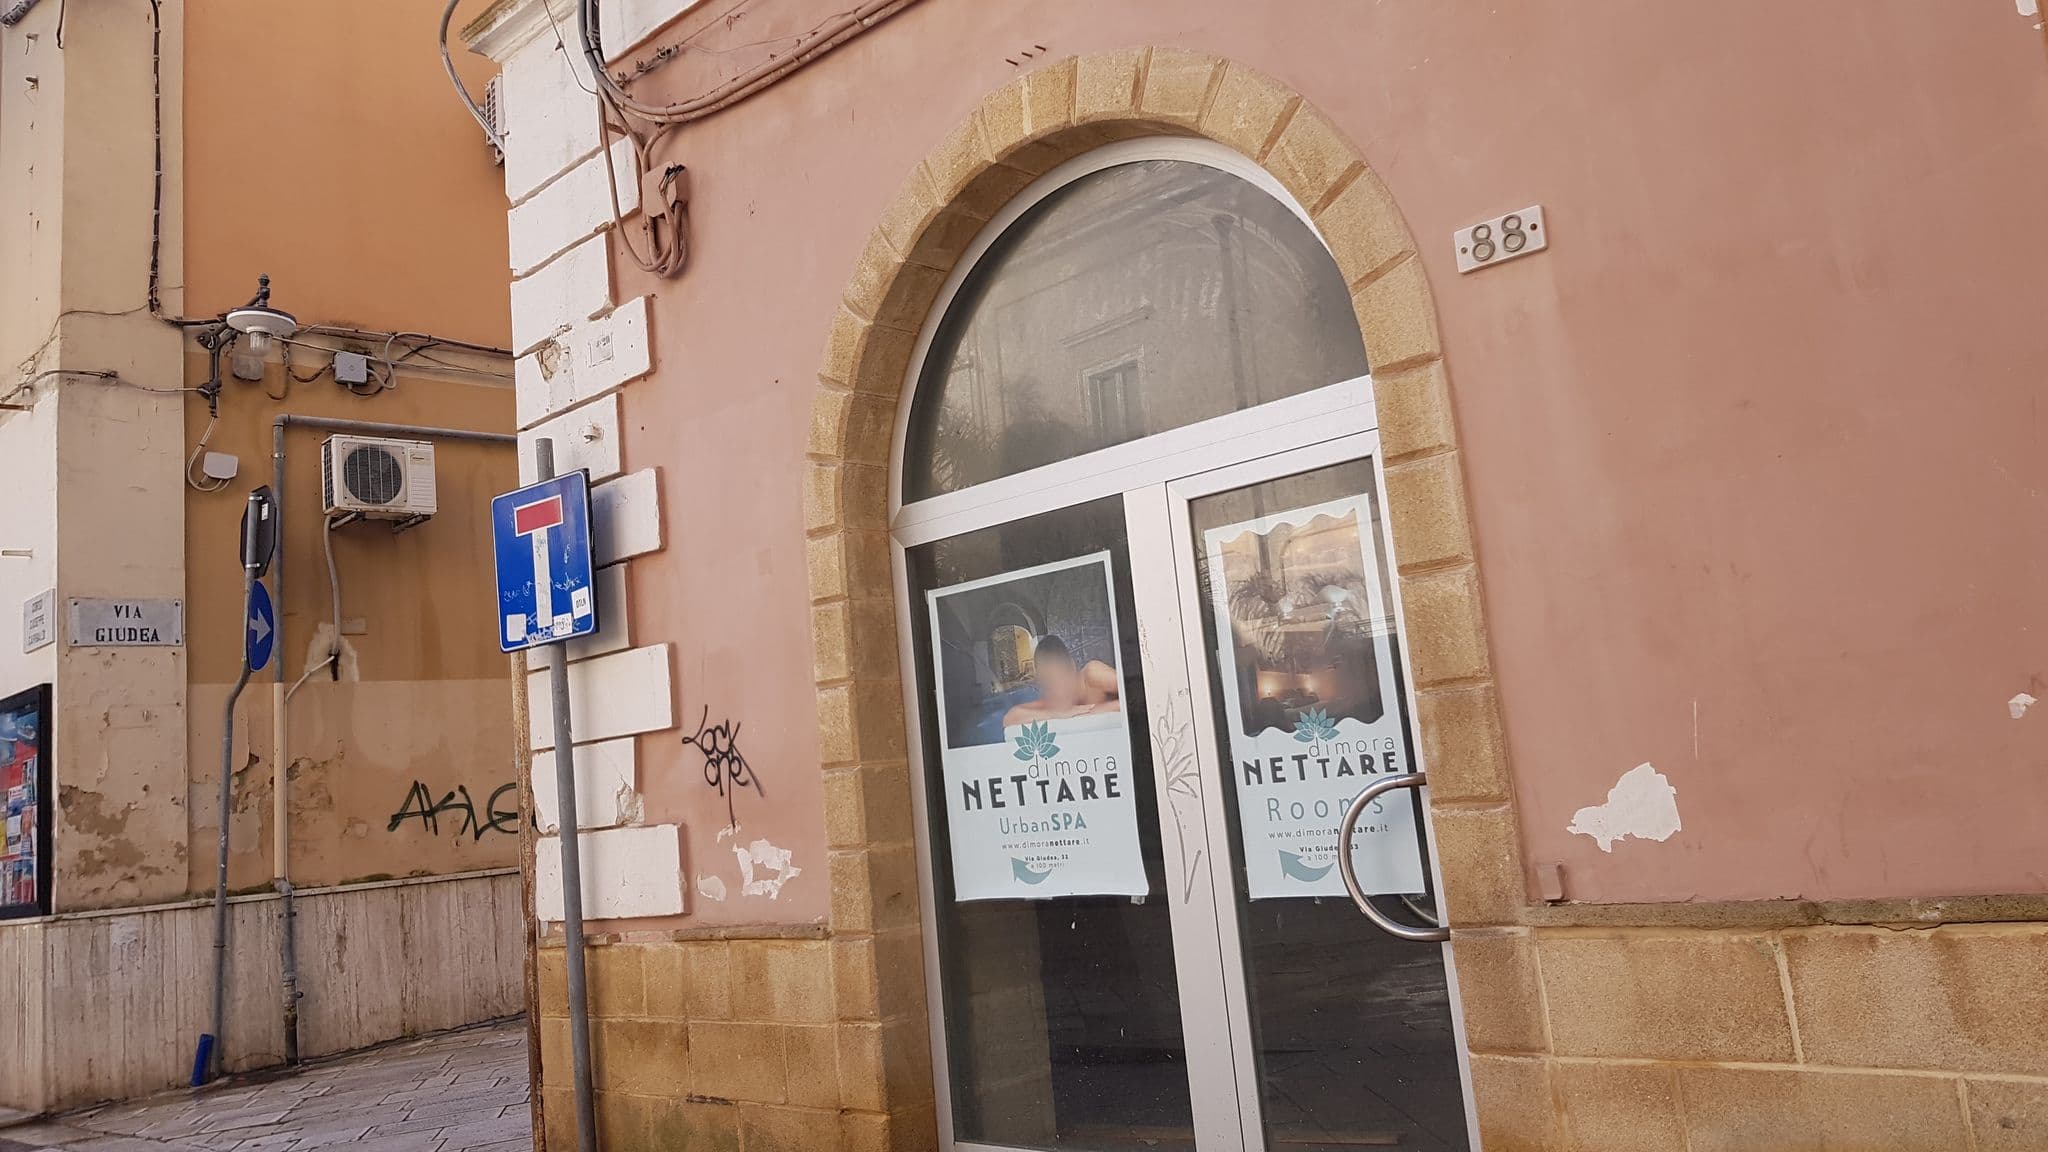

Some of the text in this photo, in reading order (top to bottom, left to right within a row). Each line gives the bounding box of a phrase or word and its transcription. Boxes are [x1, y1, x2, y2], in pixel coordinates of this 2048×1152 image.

[1471, 214, 1527, 262] 88
[113, 604, 143, 619] VIA
[95, 627, 161, 643] GIUDEA
[1309, 737, 1395, 759] dimora
[1028, 754, 1117, 779] dimora
[1242, 751, 1399, 786] NETTARE
[961, 772, 1121, 811] NETTARE
[999, 811, 1087, 835] UrbanSPA
[1001, 838, 1090, 850] www.dimoranettare.it
[1299, 845, 1312, 853] Via
